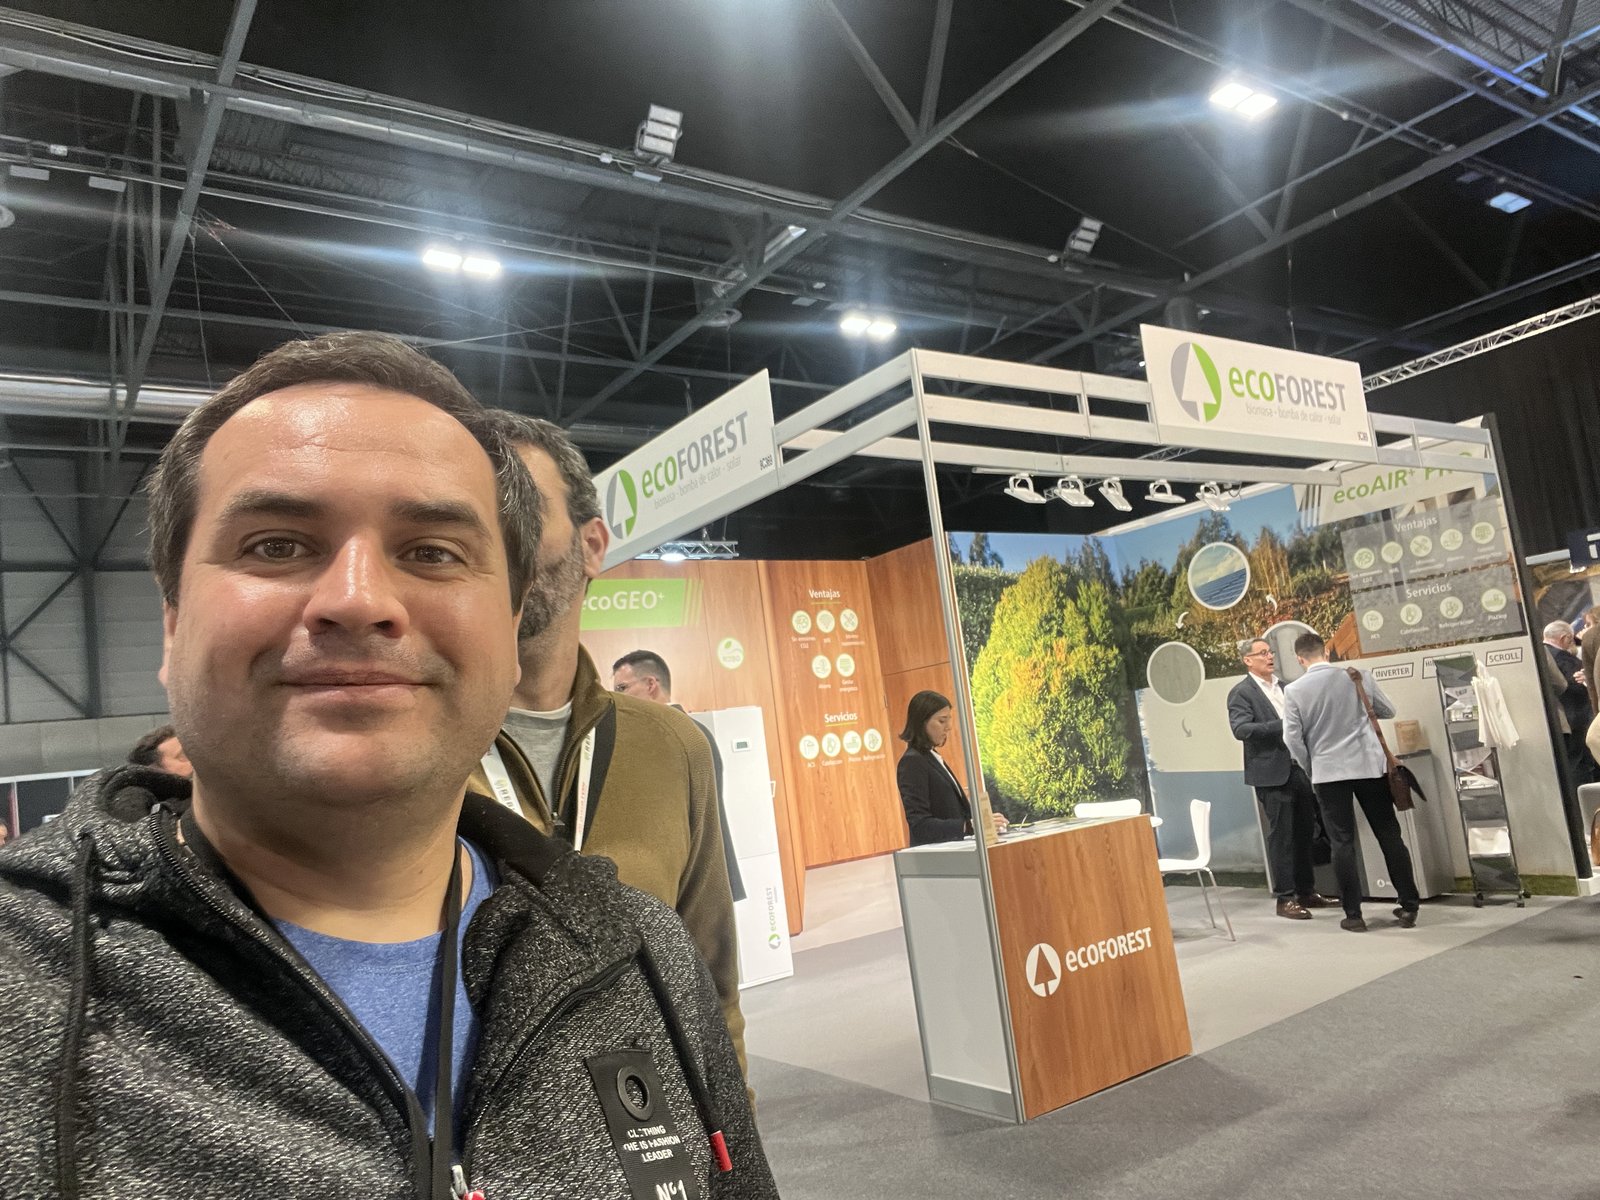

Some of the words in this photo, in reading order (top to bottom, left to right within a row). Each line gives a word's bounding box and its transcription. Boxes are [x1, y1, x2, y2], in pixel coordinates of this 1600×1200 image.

[1393, 515, 1438, 533] Ventajas
[808, 589, 841, 600] Ventajas
[1405, 582, 1453, 600] Servicios
[1488, 653, 1520, 663] SCROLL
[1375, 668, 1410, 677] INVERTER
[824, 712, 859, 723] Servicios
[641, 1149, 674, 1163] LEADER
